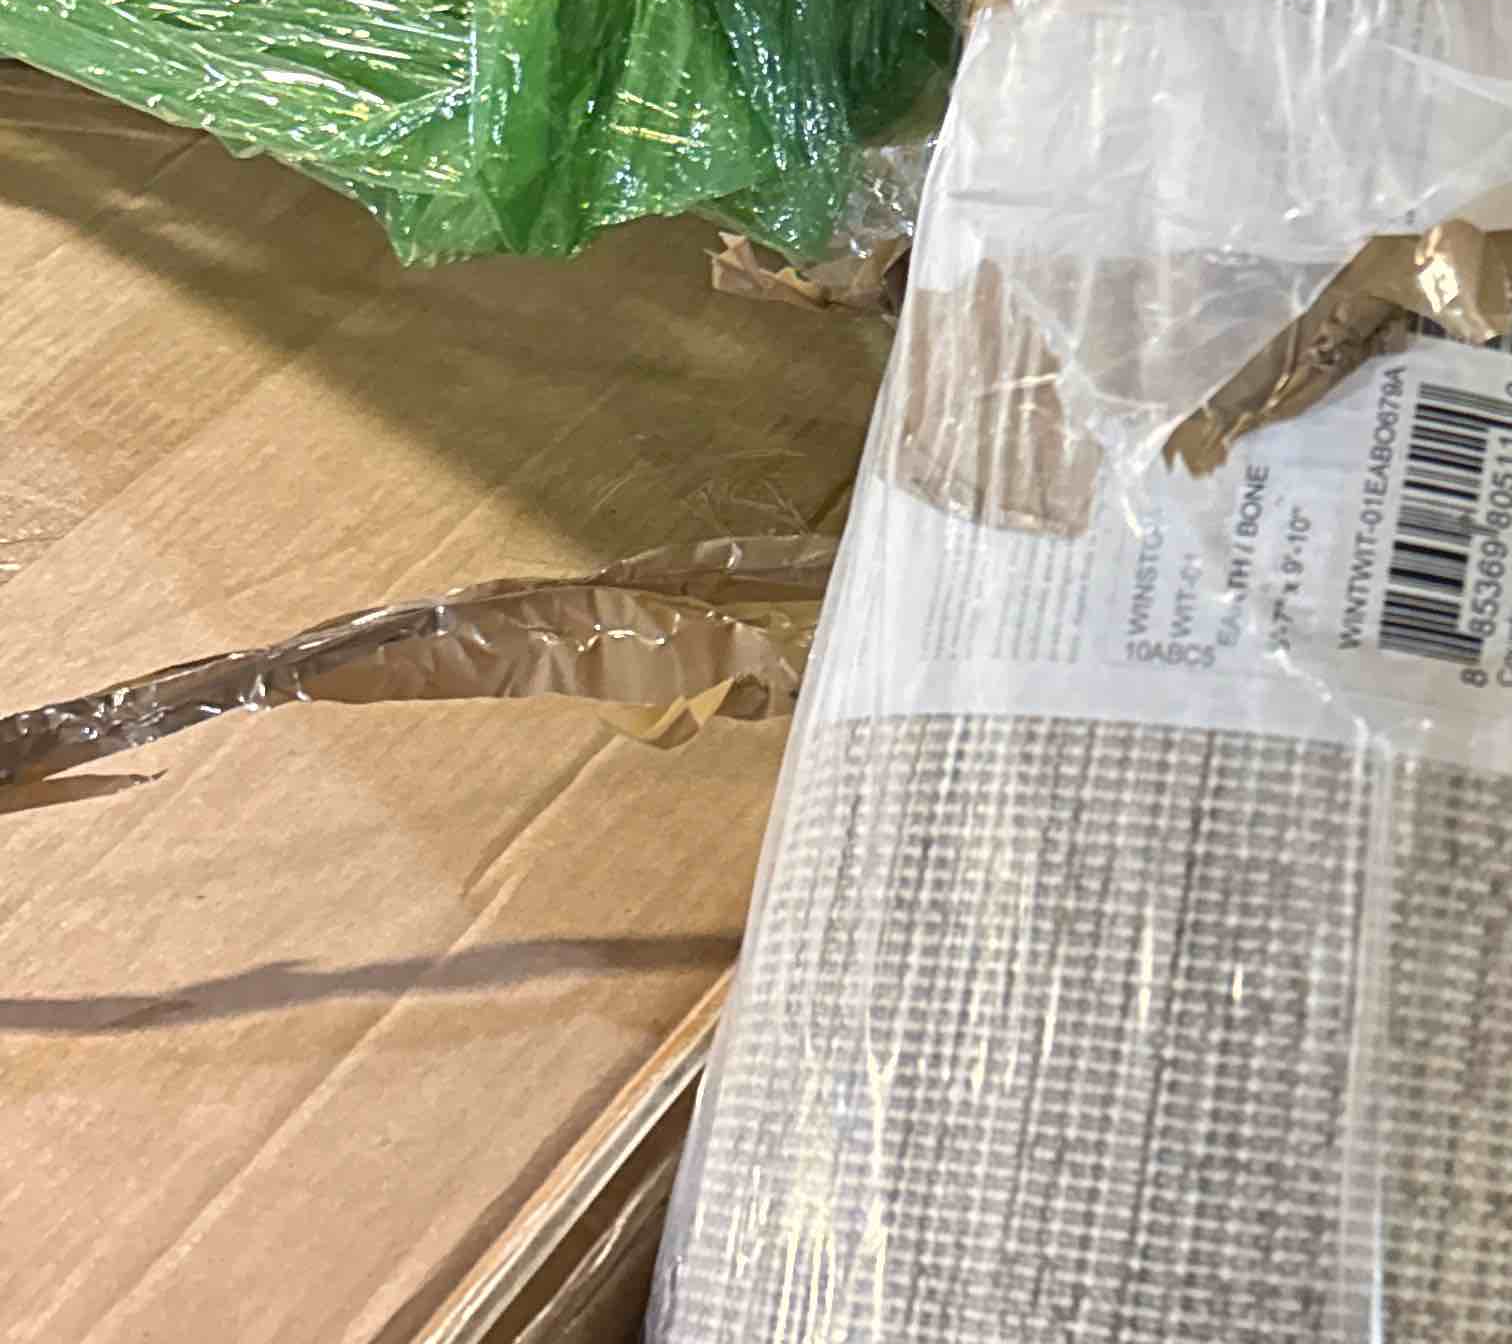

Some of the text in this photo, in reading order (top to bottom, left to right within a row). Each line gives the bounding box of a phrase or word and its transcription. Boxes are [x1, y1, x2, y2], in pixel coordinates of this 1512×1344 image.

[1235, 464, 1269, 537] BONE
[1466, 540, 1508, 638] 85369
[1459, 668, 1489, 689] 8
